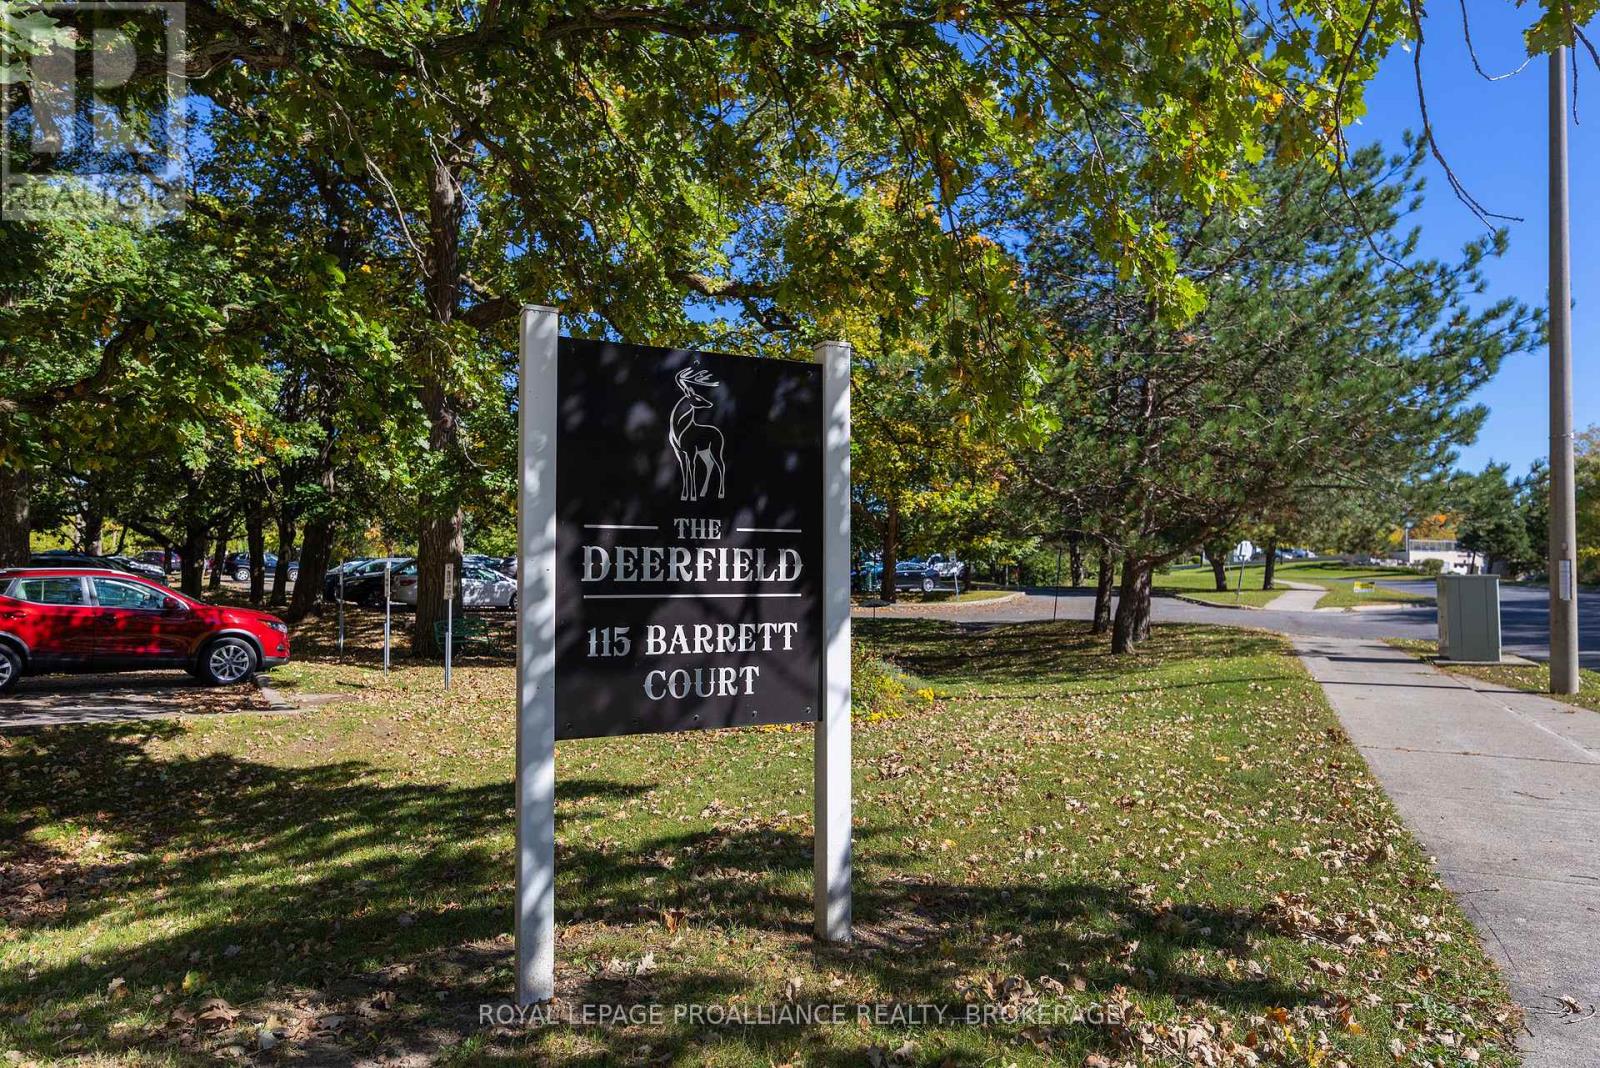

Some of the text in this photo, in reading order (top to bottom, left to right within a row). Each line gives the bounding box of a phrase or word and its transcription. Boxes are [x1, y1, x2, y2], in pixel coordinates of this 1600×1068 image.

[673, 518, 722, 540] THE
[581, 545, 804, 582] DEERFIELD
[587, 622, 798, 657] 115 BARRETT
[643, 666, 760, 700] COURT
